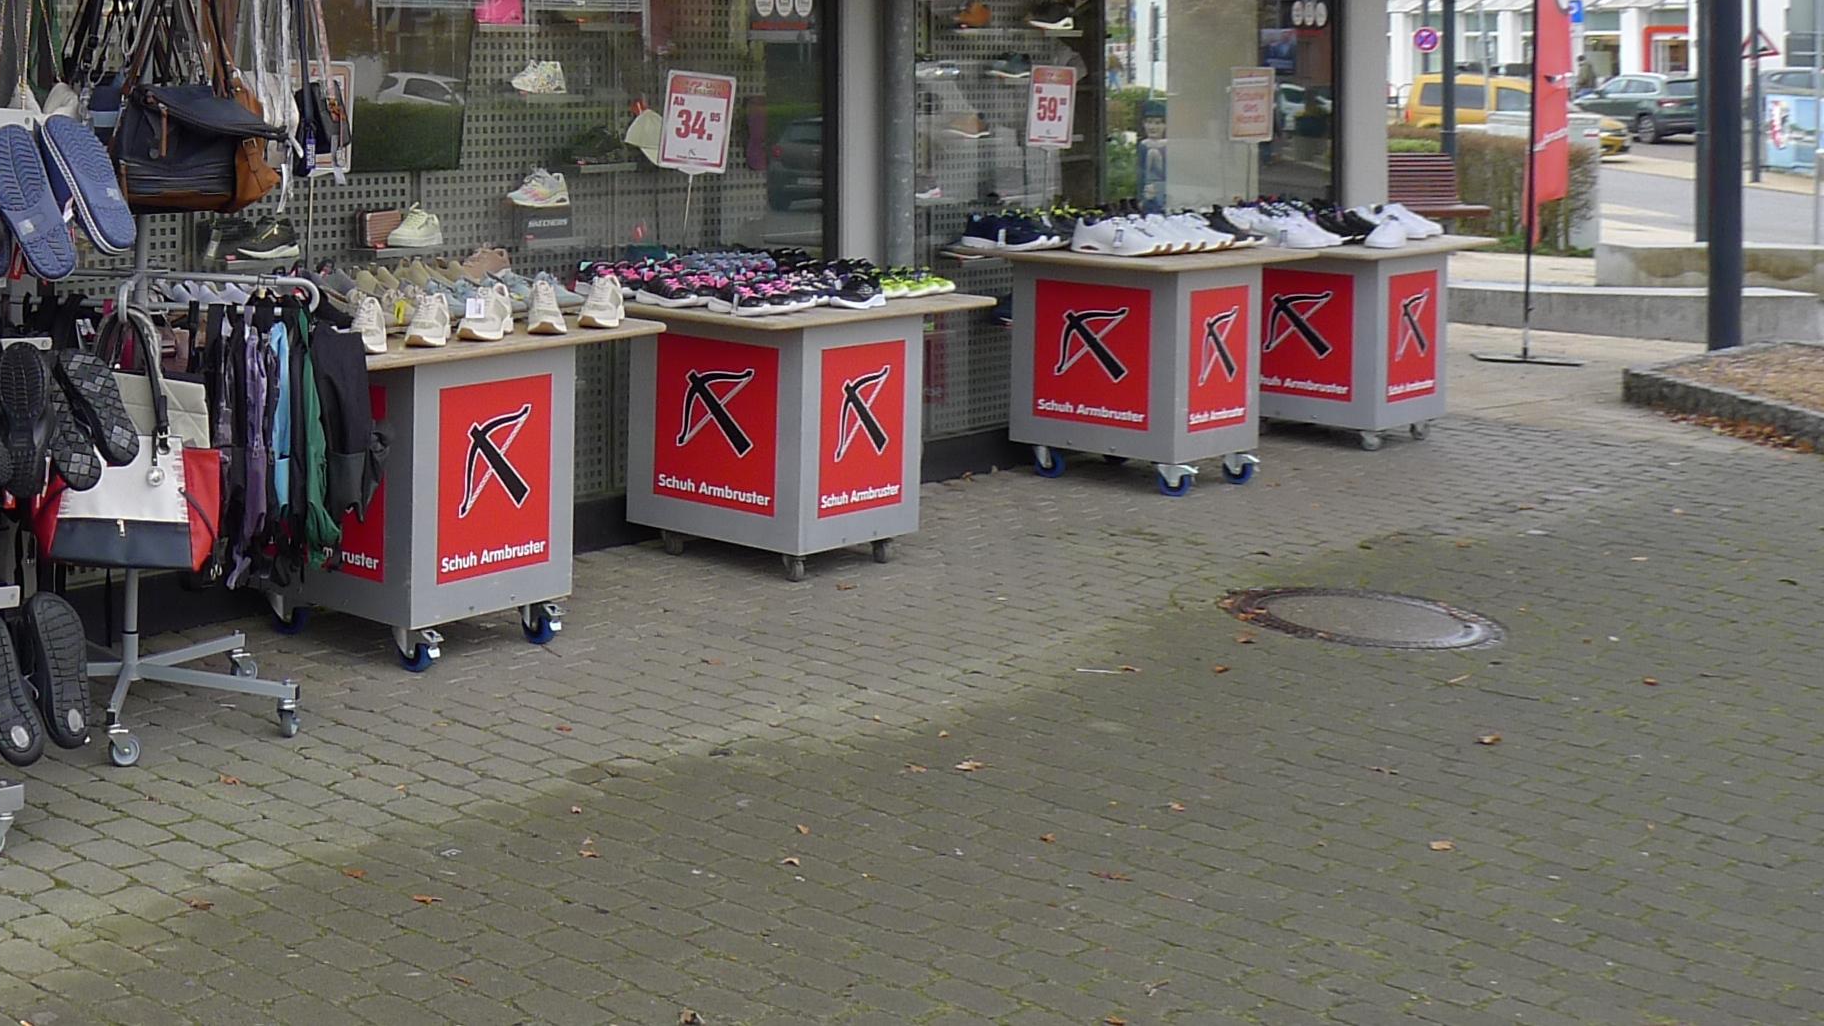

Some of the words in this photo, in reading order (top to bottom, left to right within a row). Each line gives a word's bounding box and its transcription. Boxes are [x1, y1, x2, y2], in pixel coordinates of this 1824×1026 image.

[1283, 378, 1349, 395] Armbruster
[1037, 398, 1074, 414] Schuh
[1076, 403, 1146, 423] Armbruster
[1189, 411, 1210, 424] Schuh
[658, 473, 695, 493] Schuh
[699, 480, 771, 507] Armbruster
[821, 493, 848, 510] Schuh
[850, 482, 901, 504] Armbruster
[441, 554, 477, 573] Schuh
[480, 539, 545, 565] Armbruster
